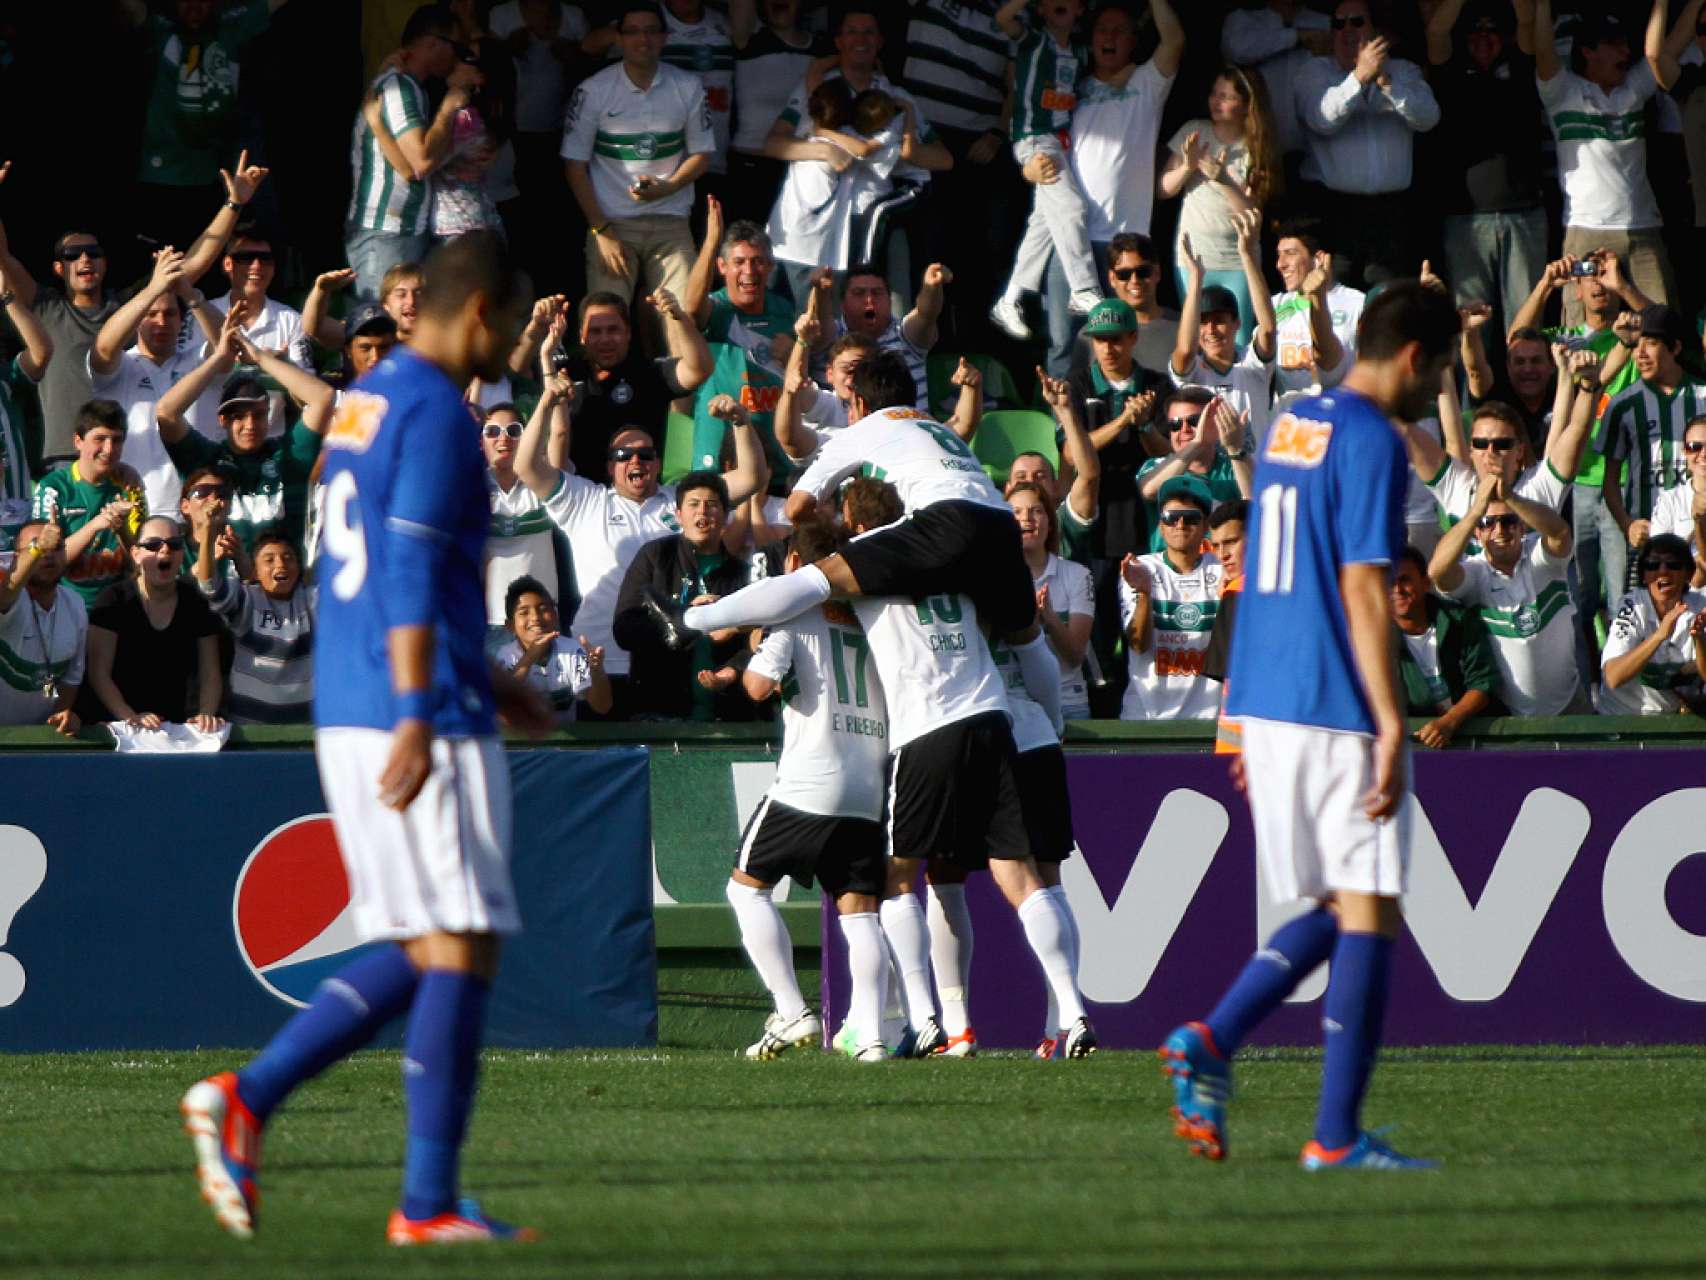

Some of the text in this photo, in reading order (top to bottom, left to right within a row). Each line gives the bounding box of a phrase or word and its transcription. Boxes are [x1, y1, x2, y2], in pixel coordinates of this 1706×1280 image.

[1258, 484, 1297, 594] 11
[829, 627, 869, 708] 17
[929, 632, 967, 652] CHICO
